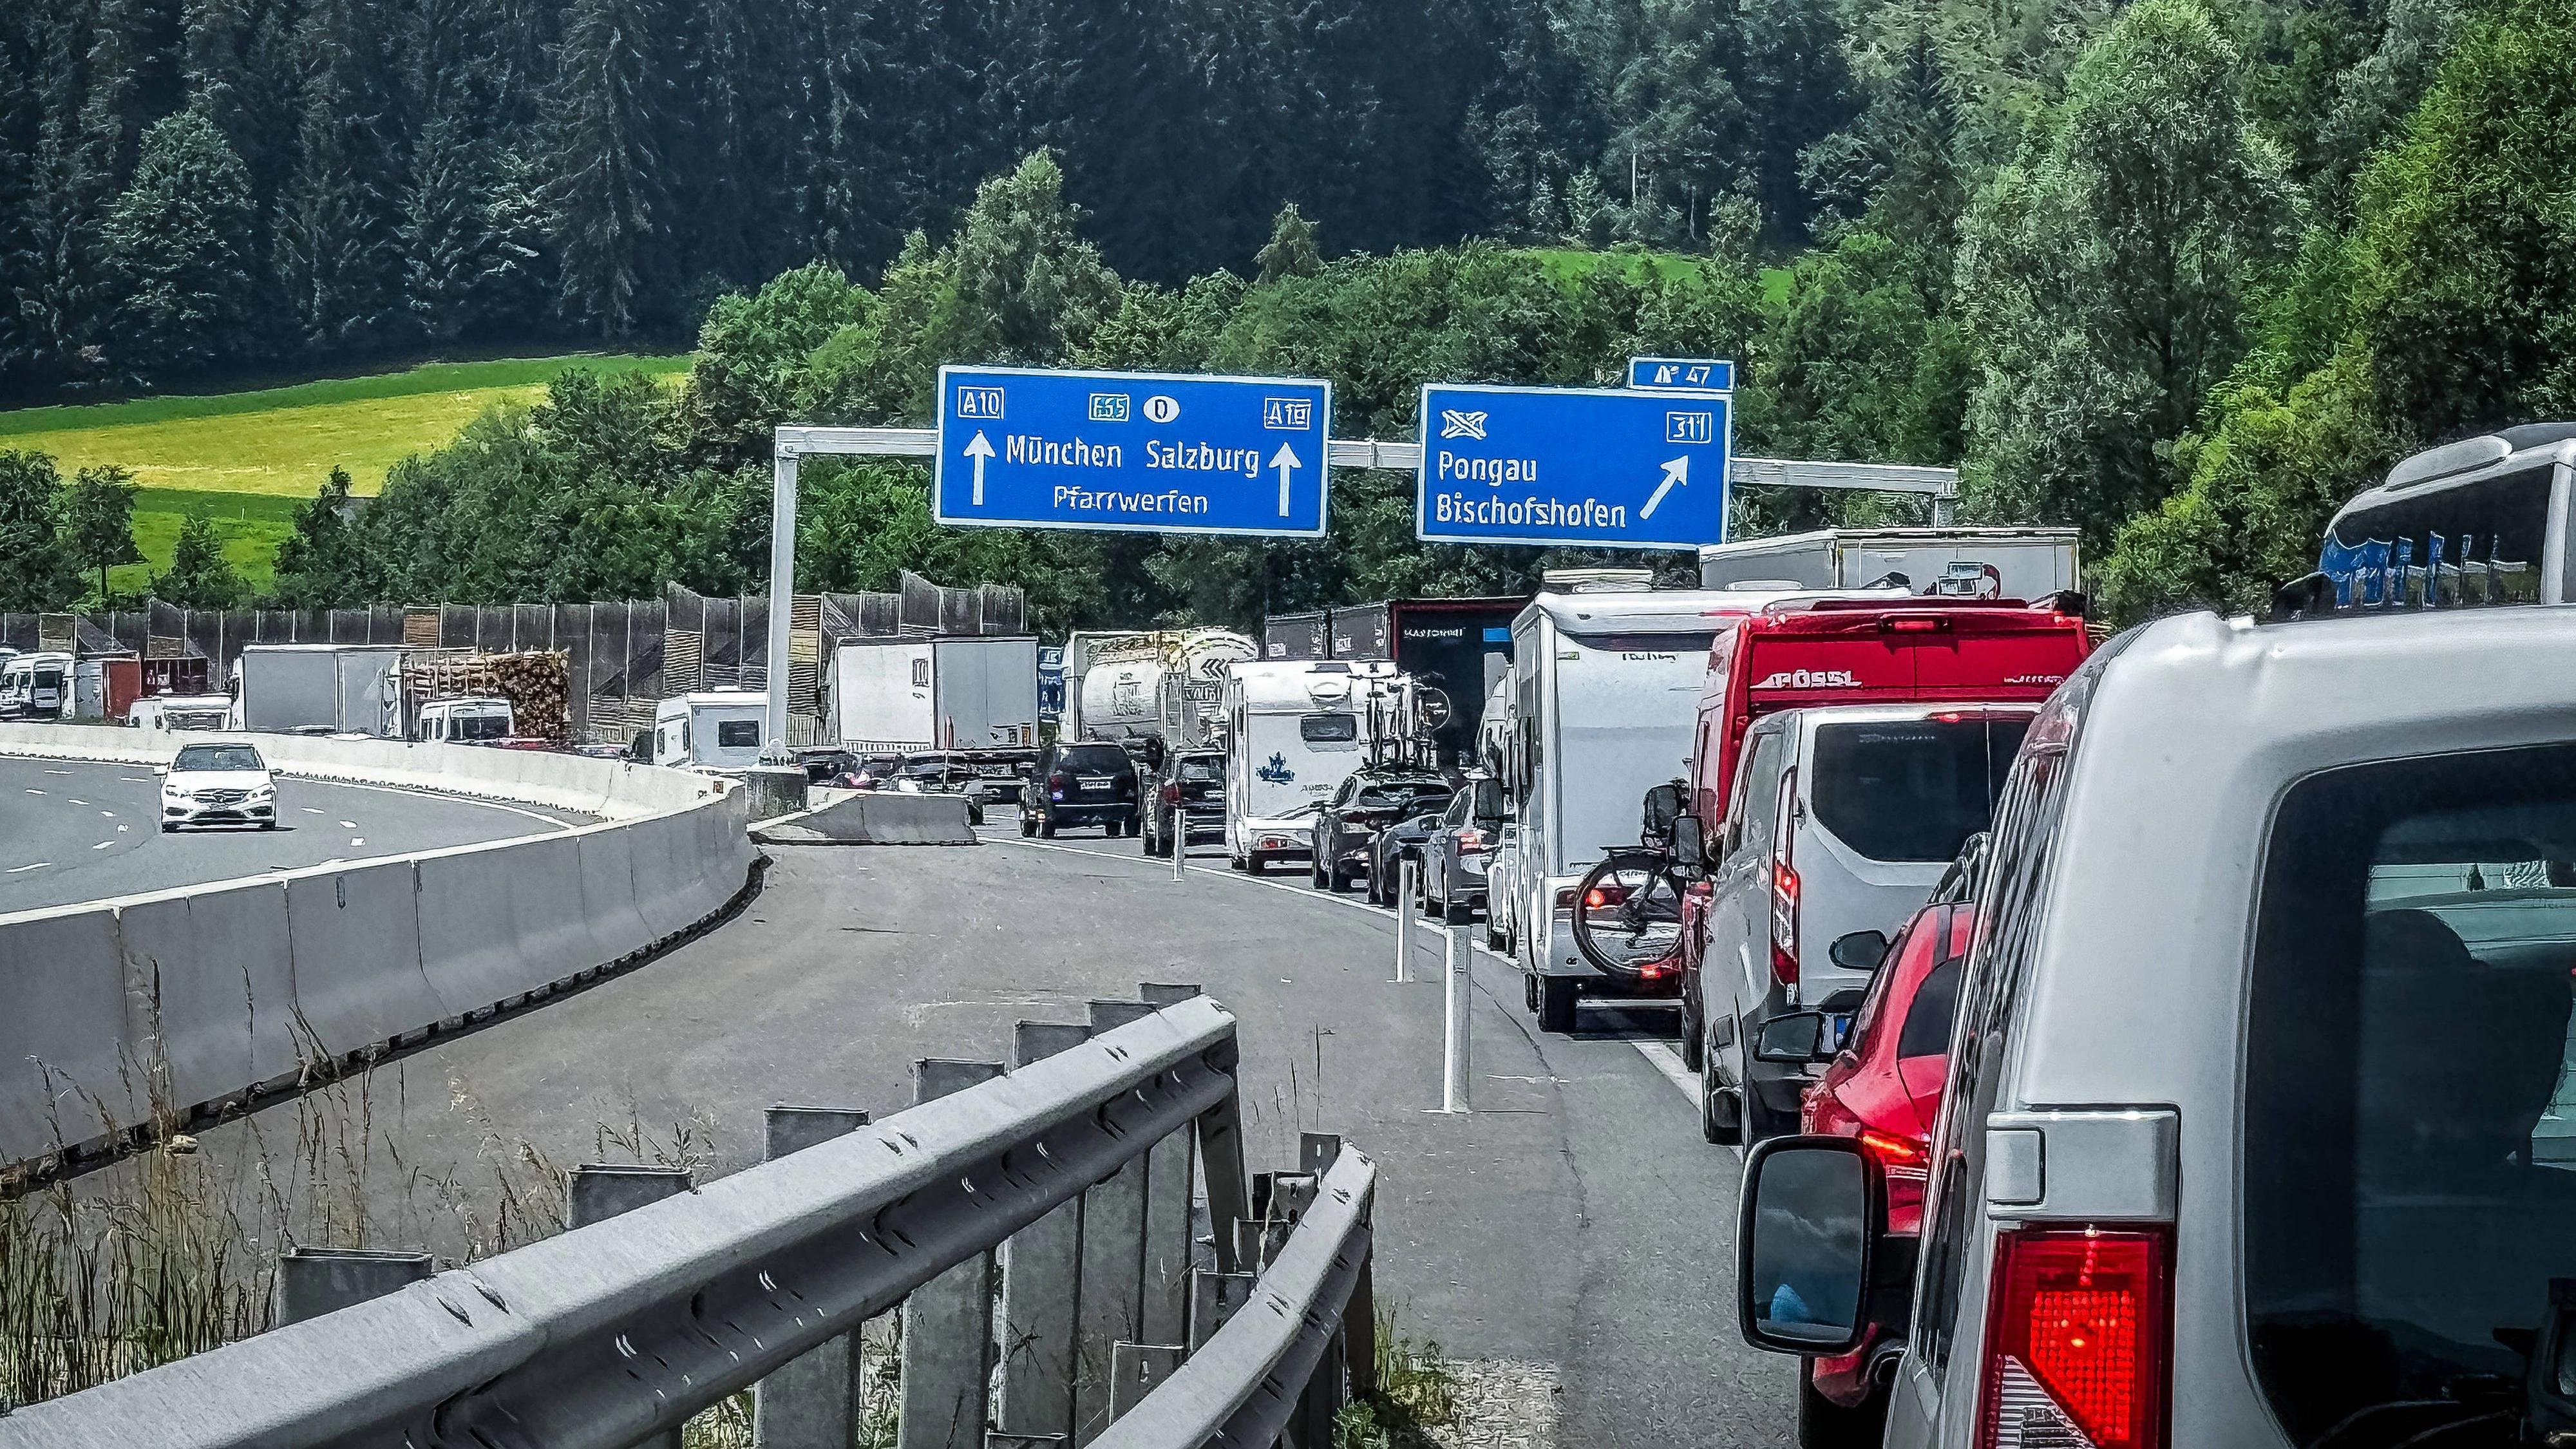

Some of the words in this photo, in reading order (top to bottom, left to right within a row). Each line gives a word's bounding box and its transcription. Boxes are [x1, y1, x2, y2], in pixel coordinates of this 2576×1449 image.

[1685, 366, 1711, 386] 47
[962, 392, 1000, 415] A10
[1094, 396, 1126, 418] E55
[1268, 402, 1307, 425] A10
[1671, 415, 1705, 440] 311
[1006, 435, 1121, 468] München
[1146, 439, 1260, 478] Salzburg
[1439, 451, 1537, 487] Pongau
[1054, 485, 1208, 514] Pfarrwerfen
[1437, 492, 1626, 527] Bischofshofen
